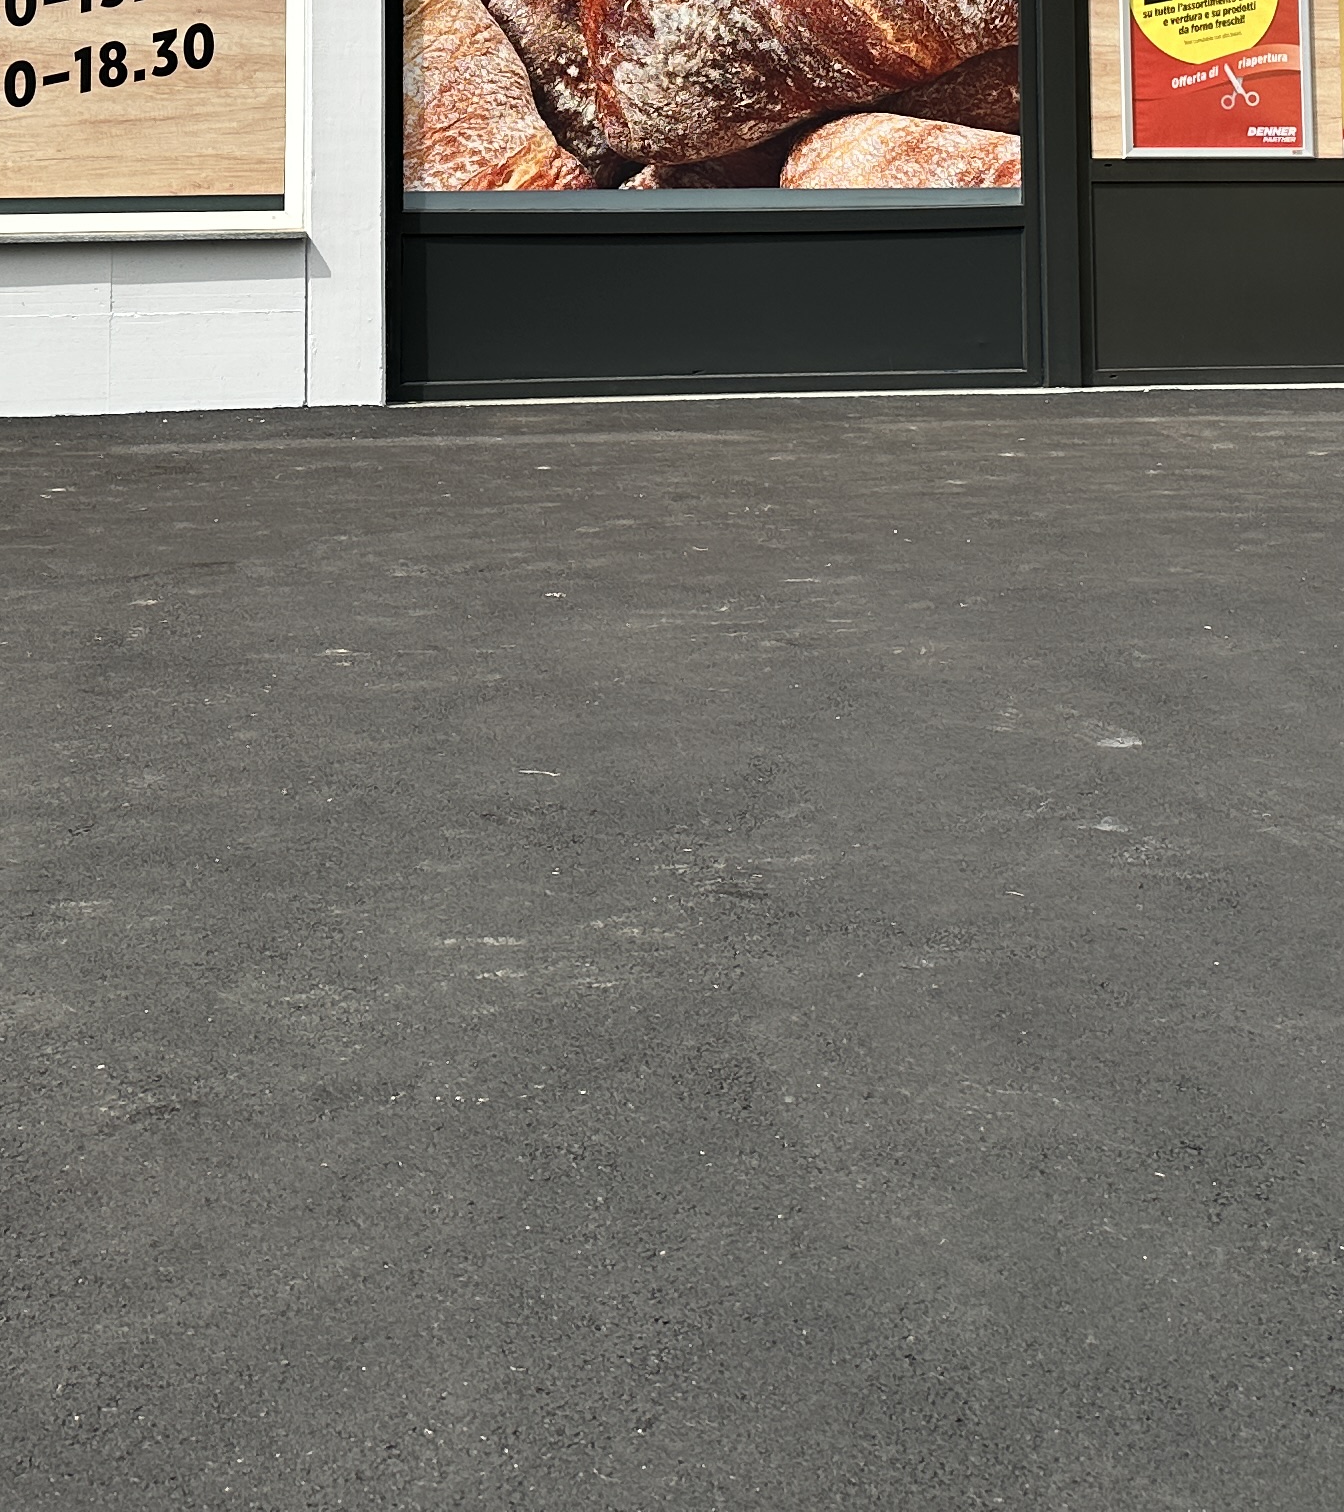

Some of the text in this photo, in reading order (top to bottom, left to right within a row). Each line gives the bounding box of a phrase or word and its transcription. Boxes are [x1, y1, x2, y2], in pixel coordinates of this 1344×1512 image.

[1154, 6, 1175, 16] tutto
[1170, 13, 1203, 25] verdura
[1223, 1, 1256, 16] prodotti
[1178, 25, 1189, 35] da
[1191, 21, 1213, 33] forno
[1238, 53, 1288, 69] riapertura
[1171, 65, 1219, 89] Offerta di
[1247, 126, 1297, 137] DENNER
